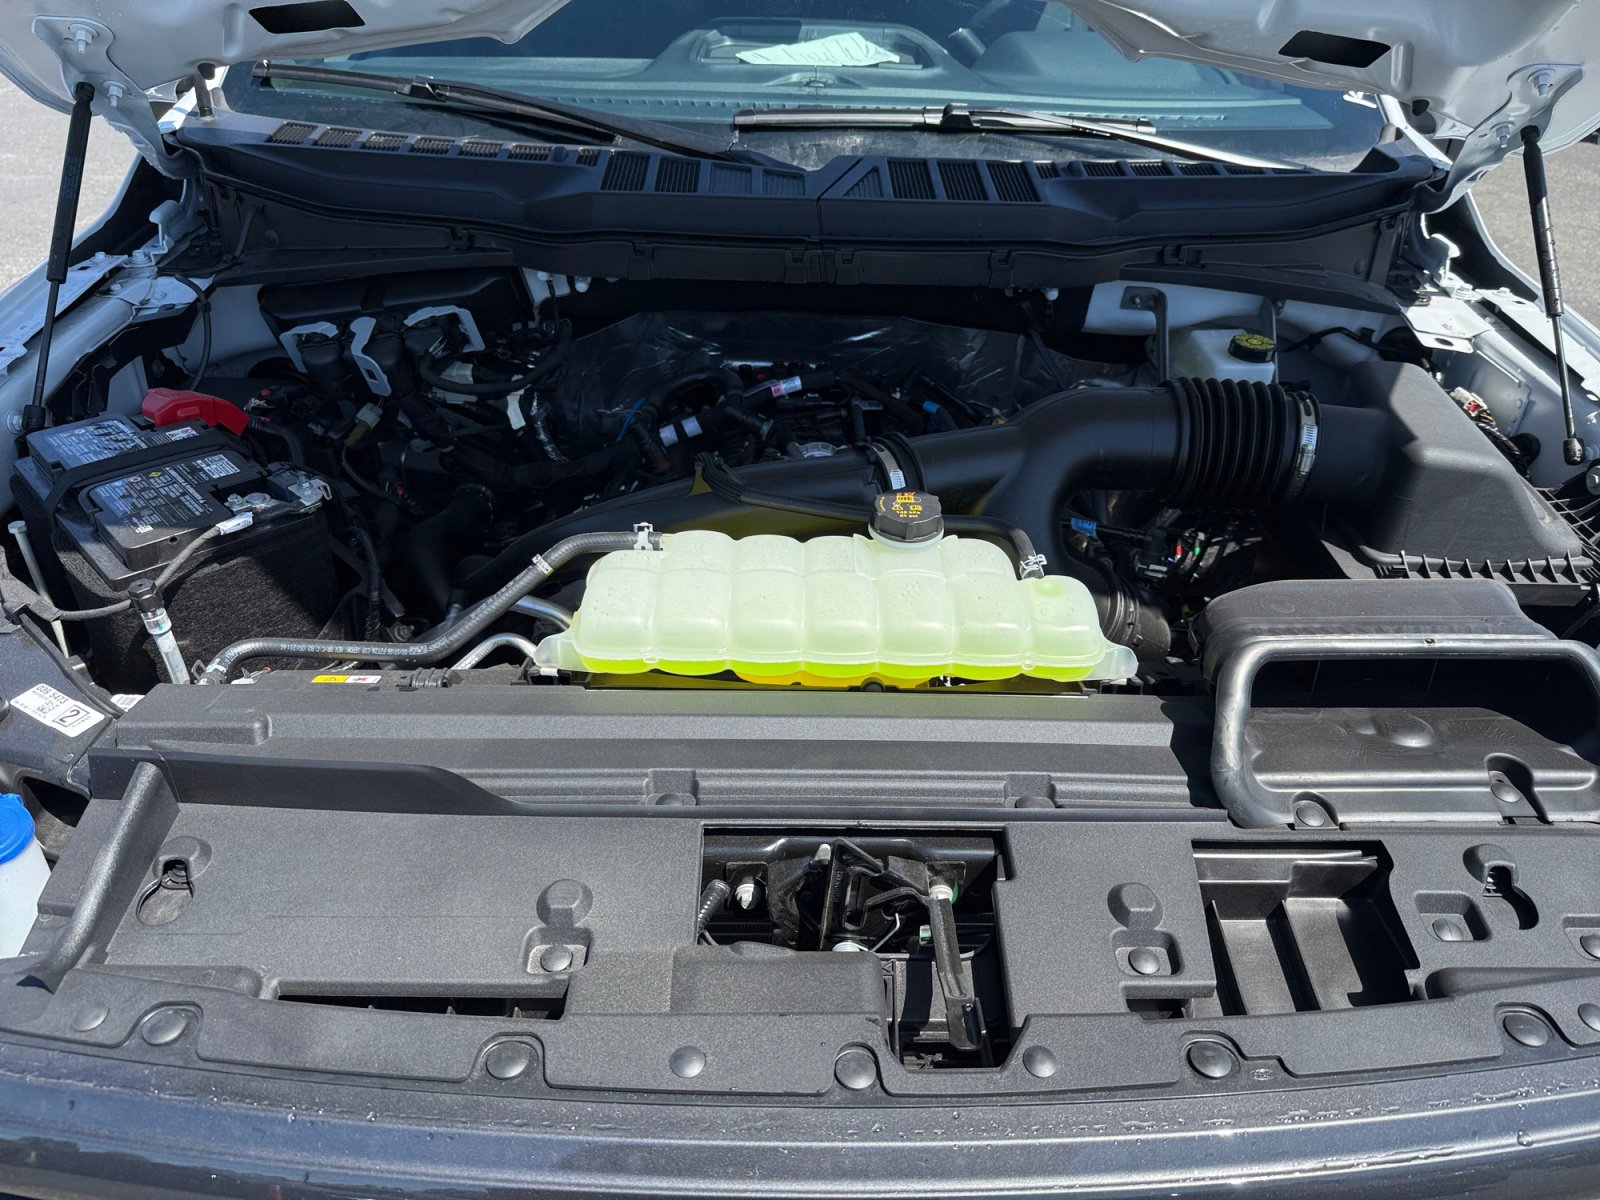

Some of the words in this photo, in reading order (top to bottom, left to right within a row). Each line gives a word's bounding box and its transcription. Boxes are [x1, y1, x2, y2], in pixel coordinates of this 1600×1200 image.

[36, 685, 50, 696] 039
[49, 691, 69, 705] 5473
[60, 709, 81, 724] 2
